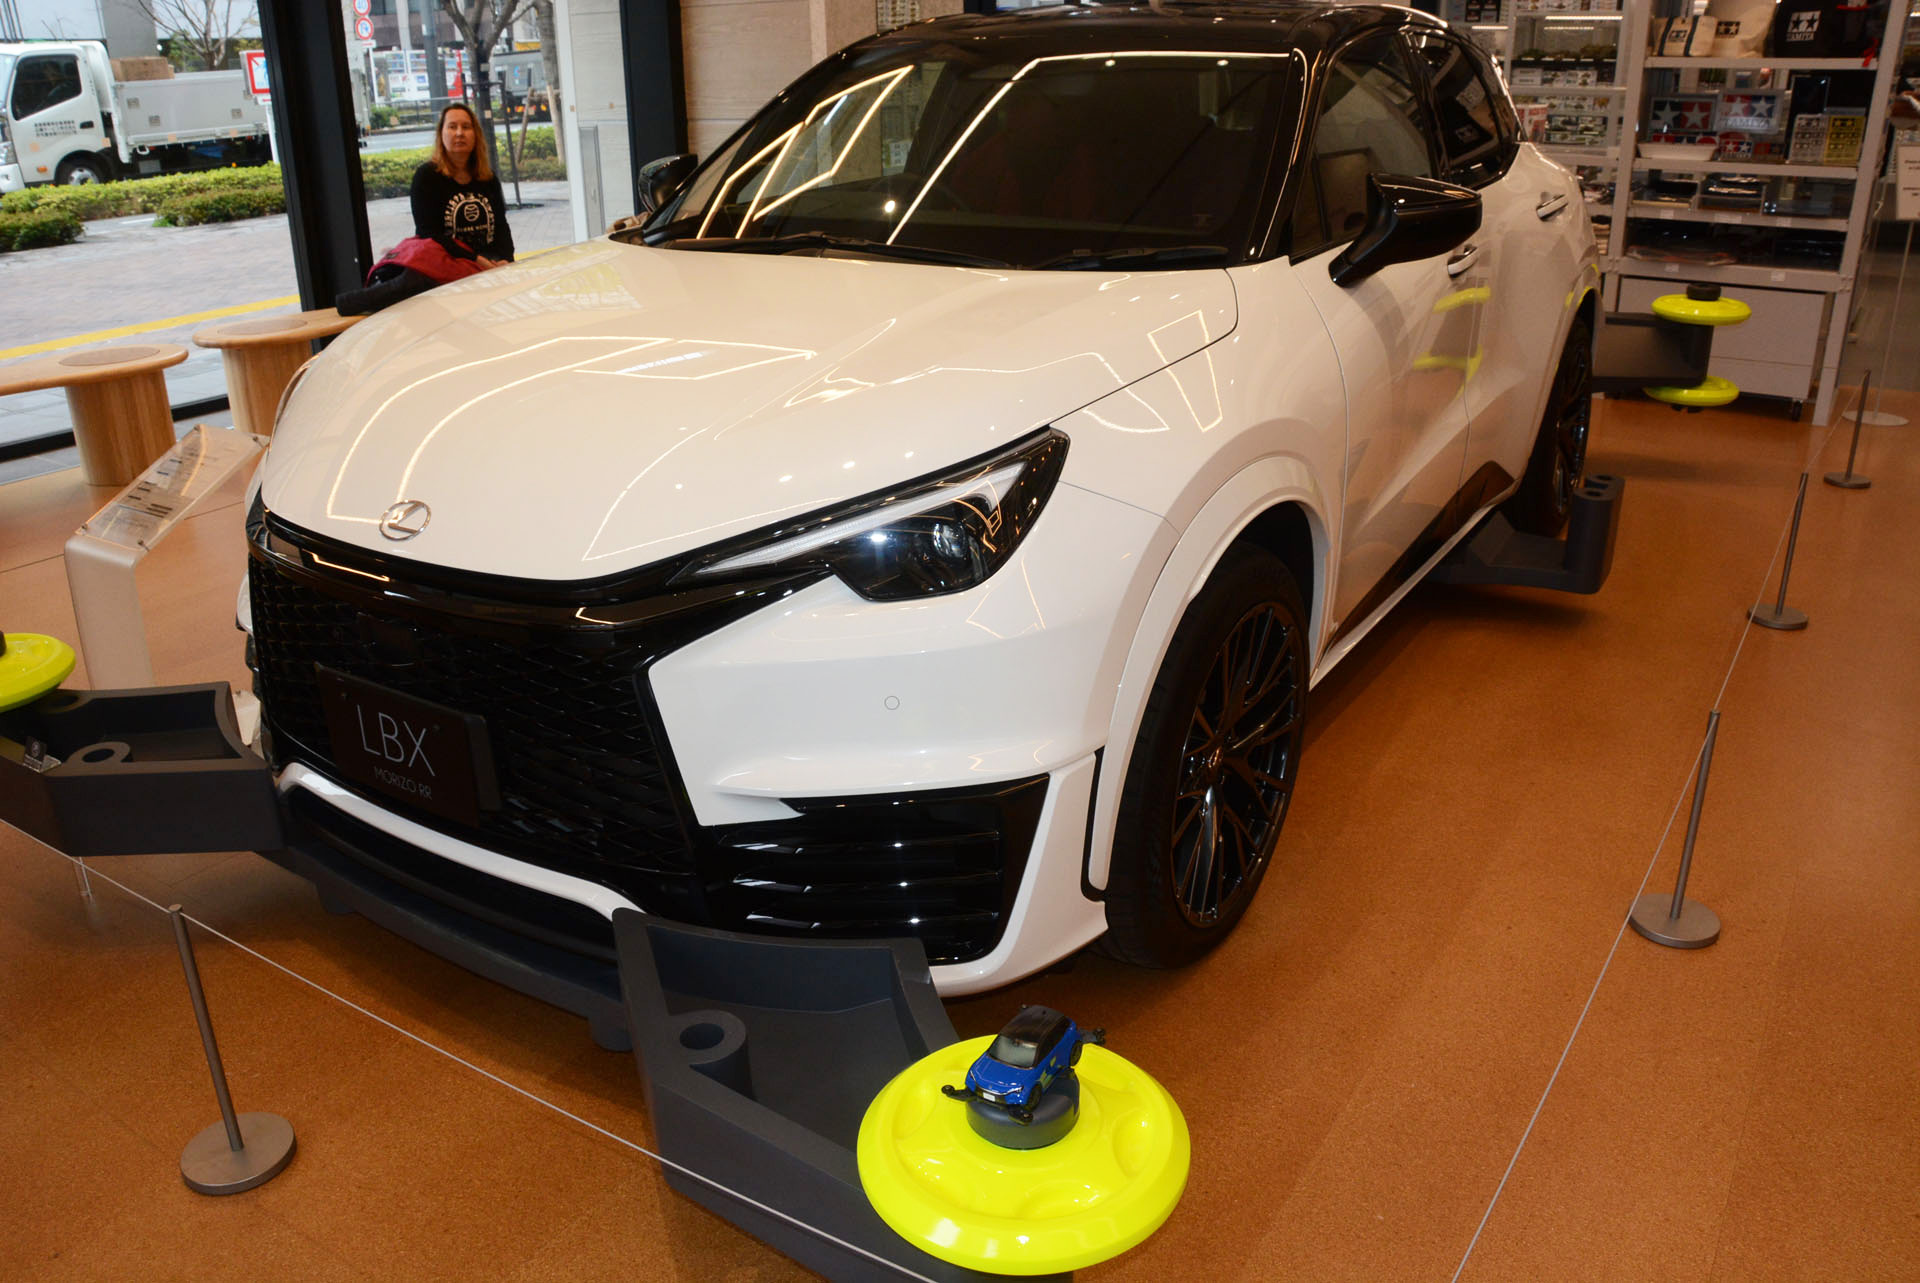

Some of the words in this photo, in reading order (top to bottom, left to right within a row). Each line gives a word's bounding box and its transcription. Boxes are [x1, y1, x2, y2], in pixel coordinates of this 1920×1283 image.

[356, 704, 435, 776] LBX
[374, 766, 416, 793] MORIZO
[418, 783, 432, 800] RR
